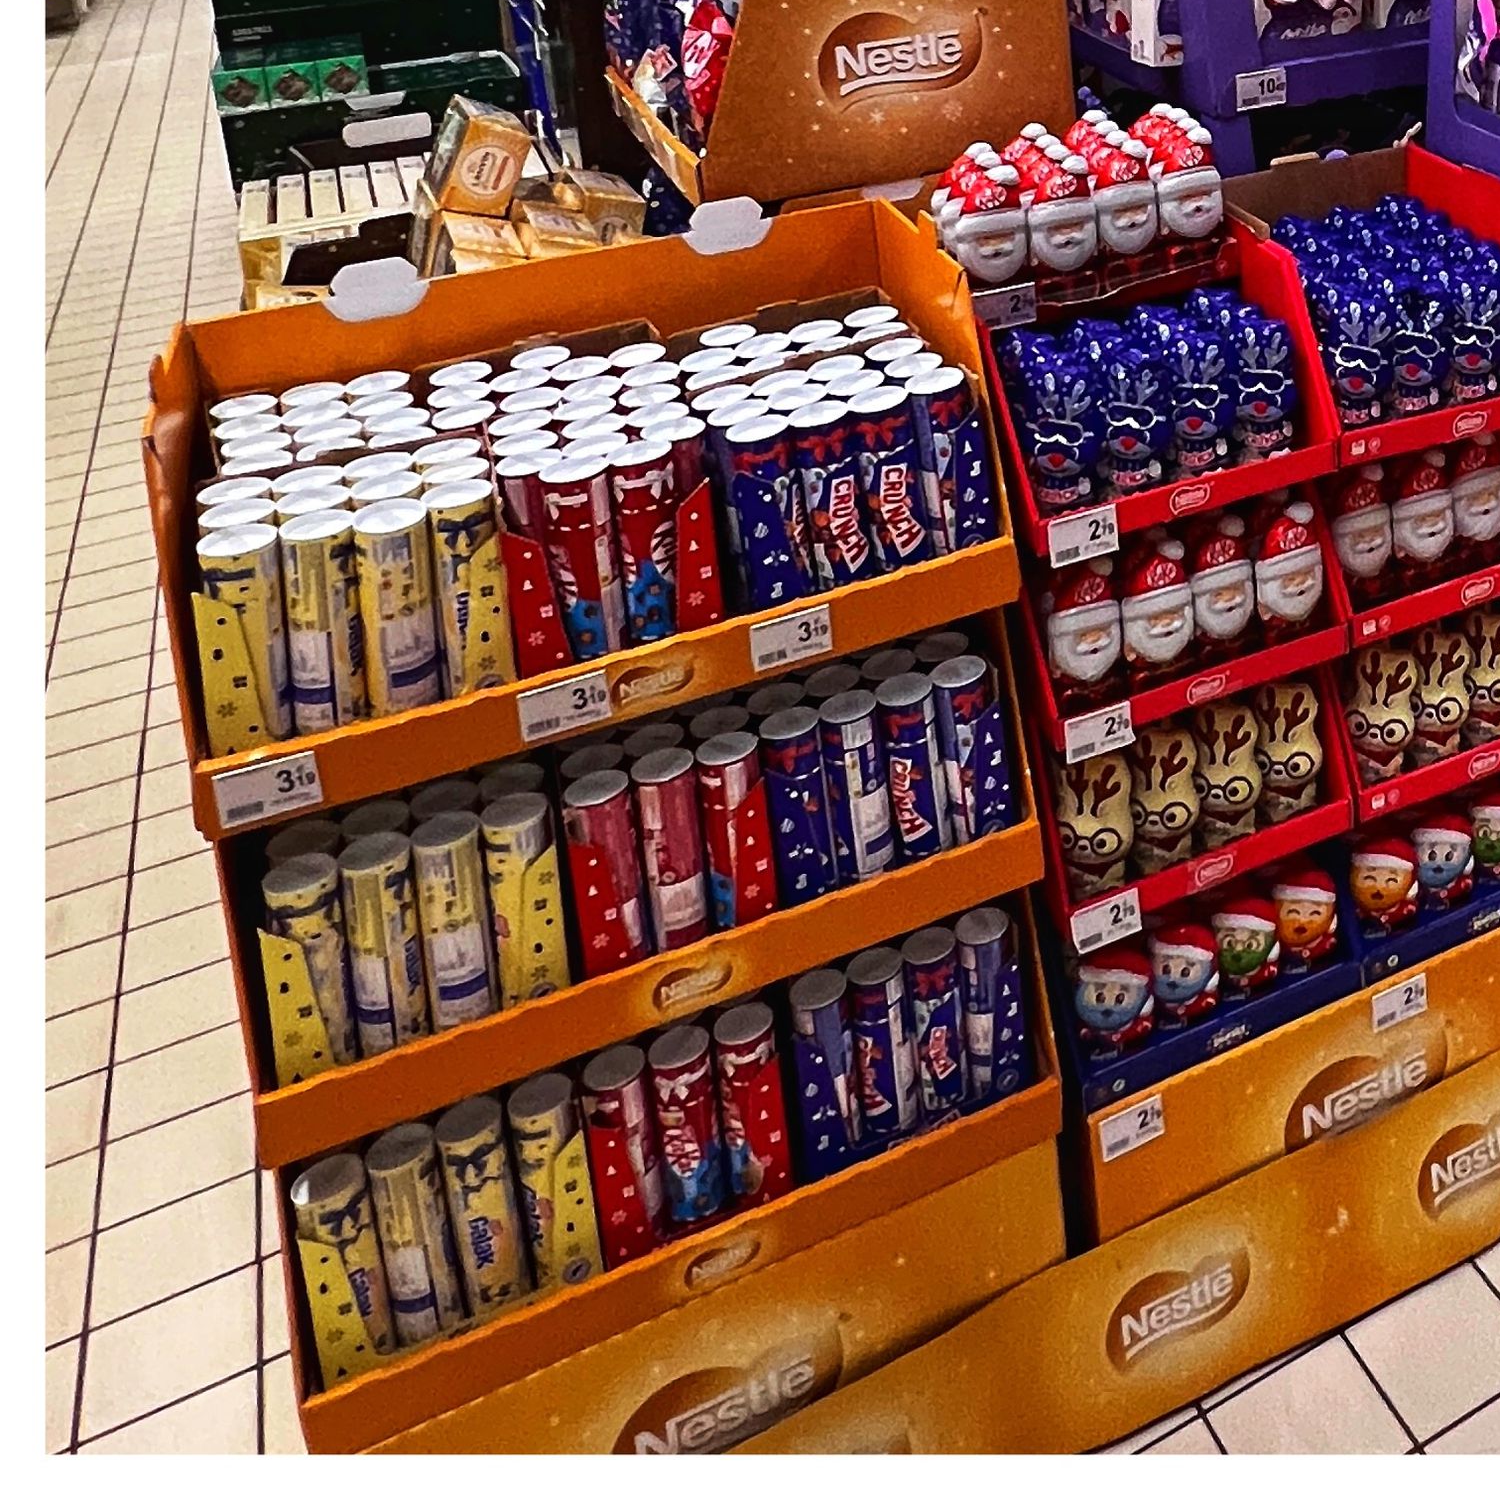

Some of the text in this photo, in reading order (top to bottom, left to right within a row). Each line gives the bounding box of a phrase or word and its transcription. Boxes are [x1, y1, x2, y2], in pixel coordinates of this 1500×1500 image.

[834, 29, 962, 80] Nestlé
[831, 480, 867, 565] CRUNCH
[882, 467, 922, 552] CRUNCH
[1302, 1052, 1428, 1138] Nestlé
[469, 1216, 494, 1270] Galak
[1121, 1263, 1234, 1346] Nestlé
[634, 1354, 816, 1455] Nestlé
